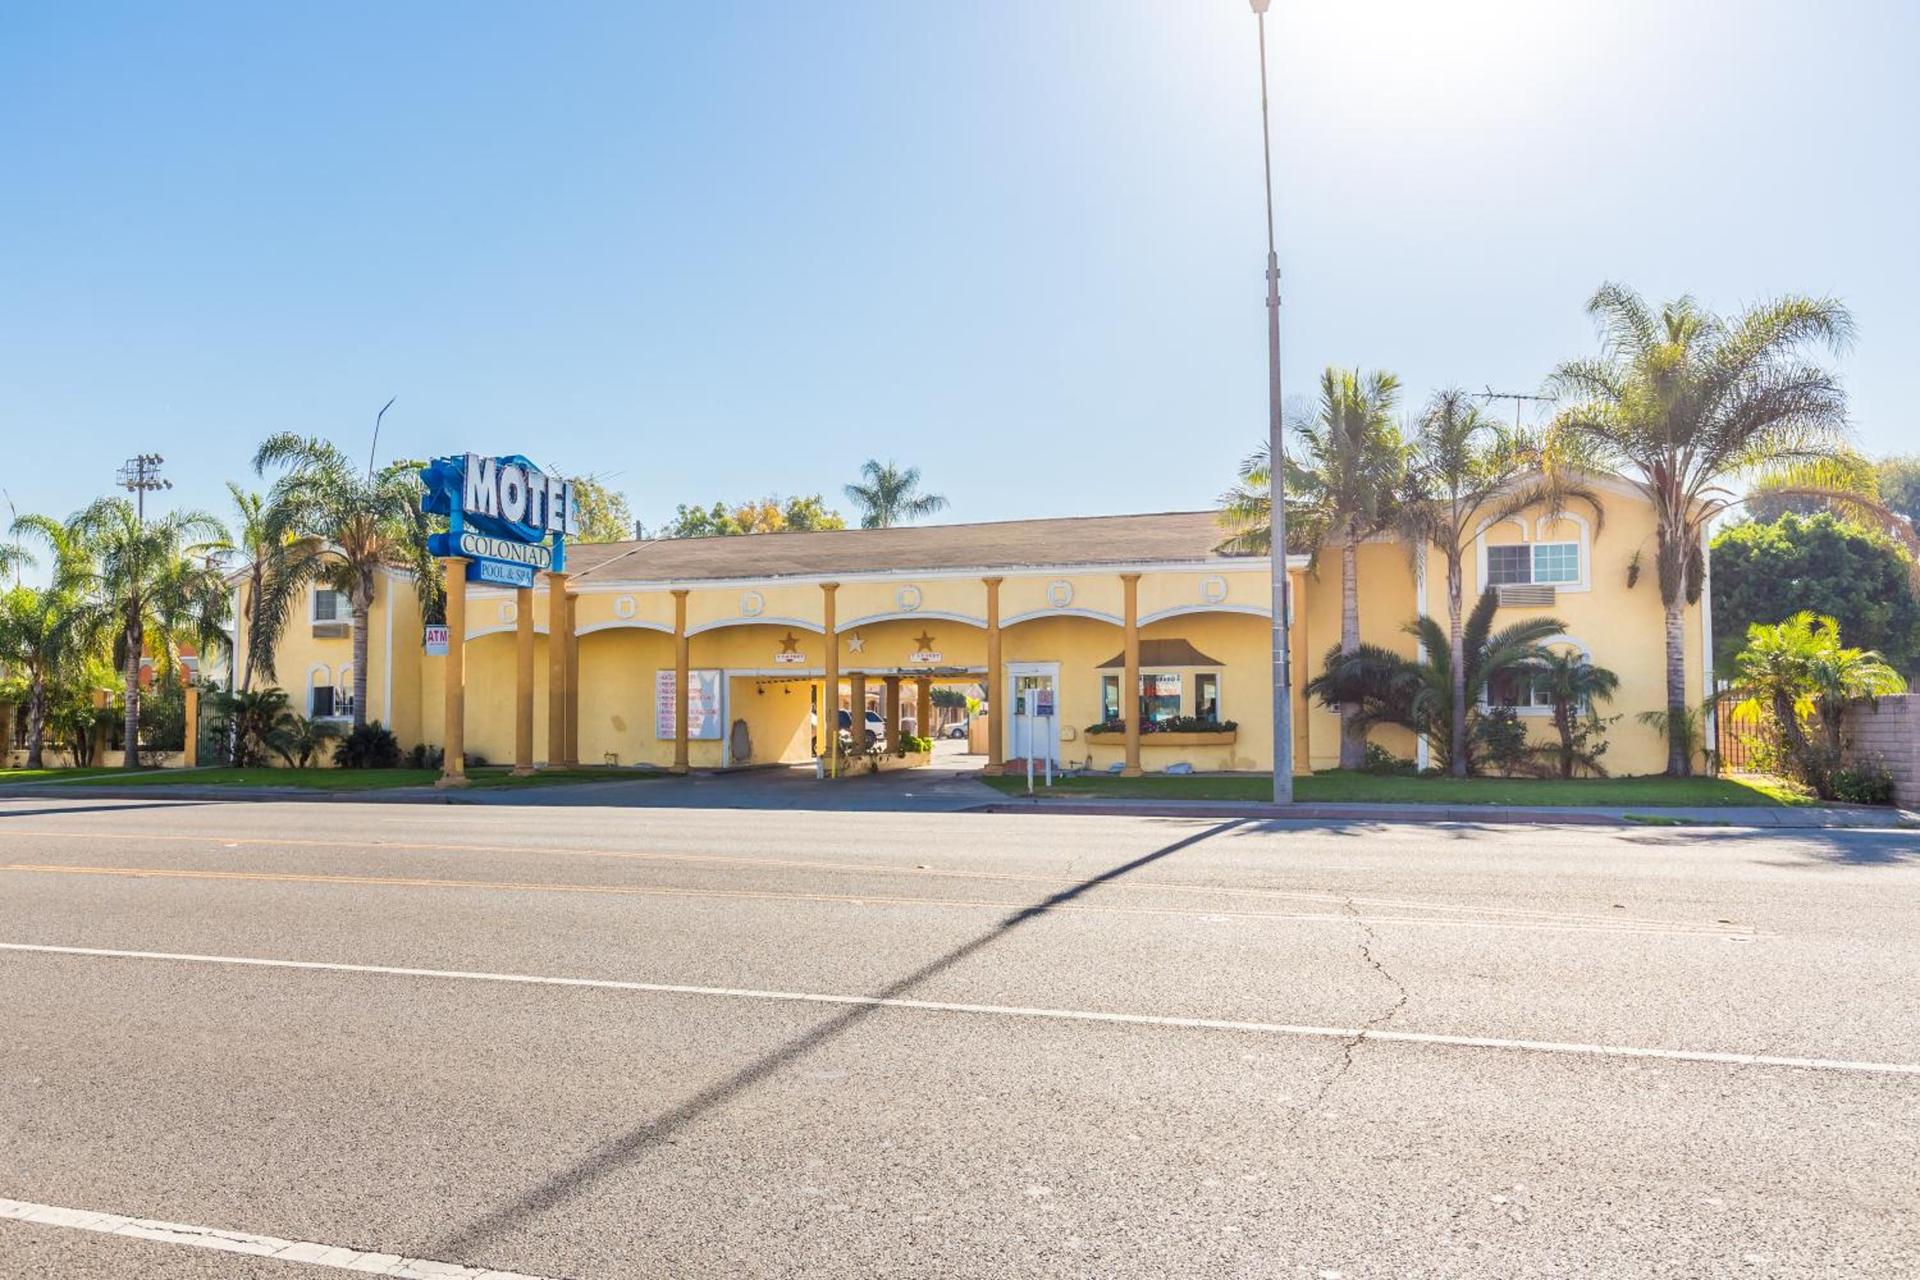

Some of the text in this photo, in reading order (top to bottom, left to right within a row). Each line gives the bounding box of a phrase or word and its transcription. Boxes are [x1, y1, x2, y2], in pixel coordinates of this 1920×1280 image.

[464, 452, 578, 536] MOTEL
[463, 534, 547, 566] COLONIAL
[482, 562, 532, 583] POOL & SPA
[428, 630, 448, 642] ATM
